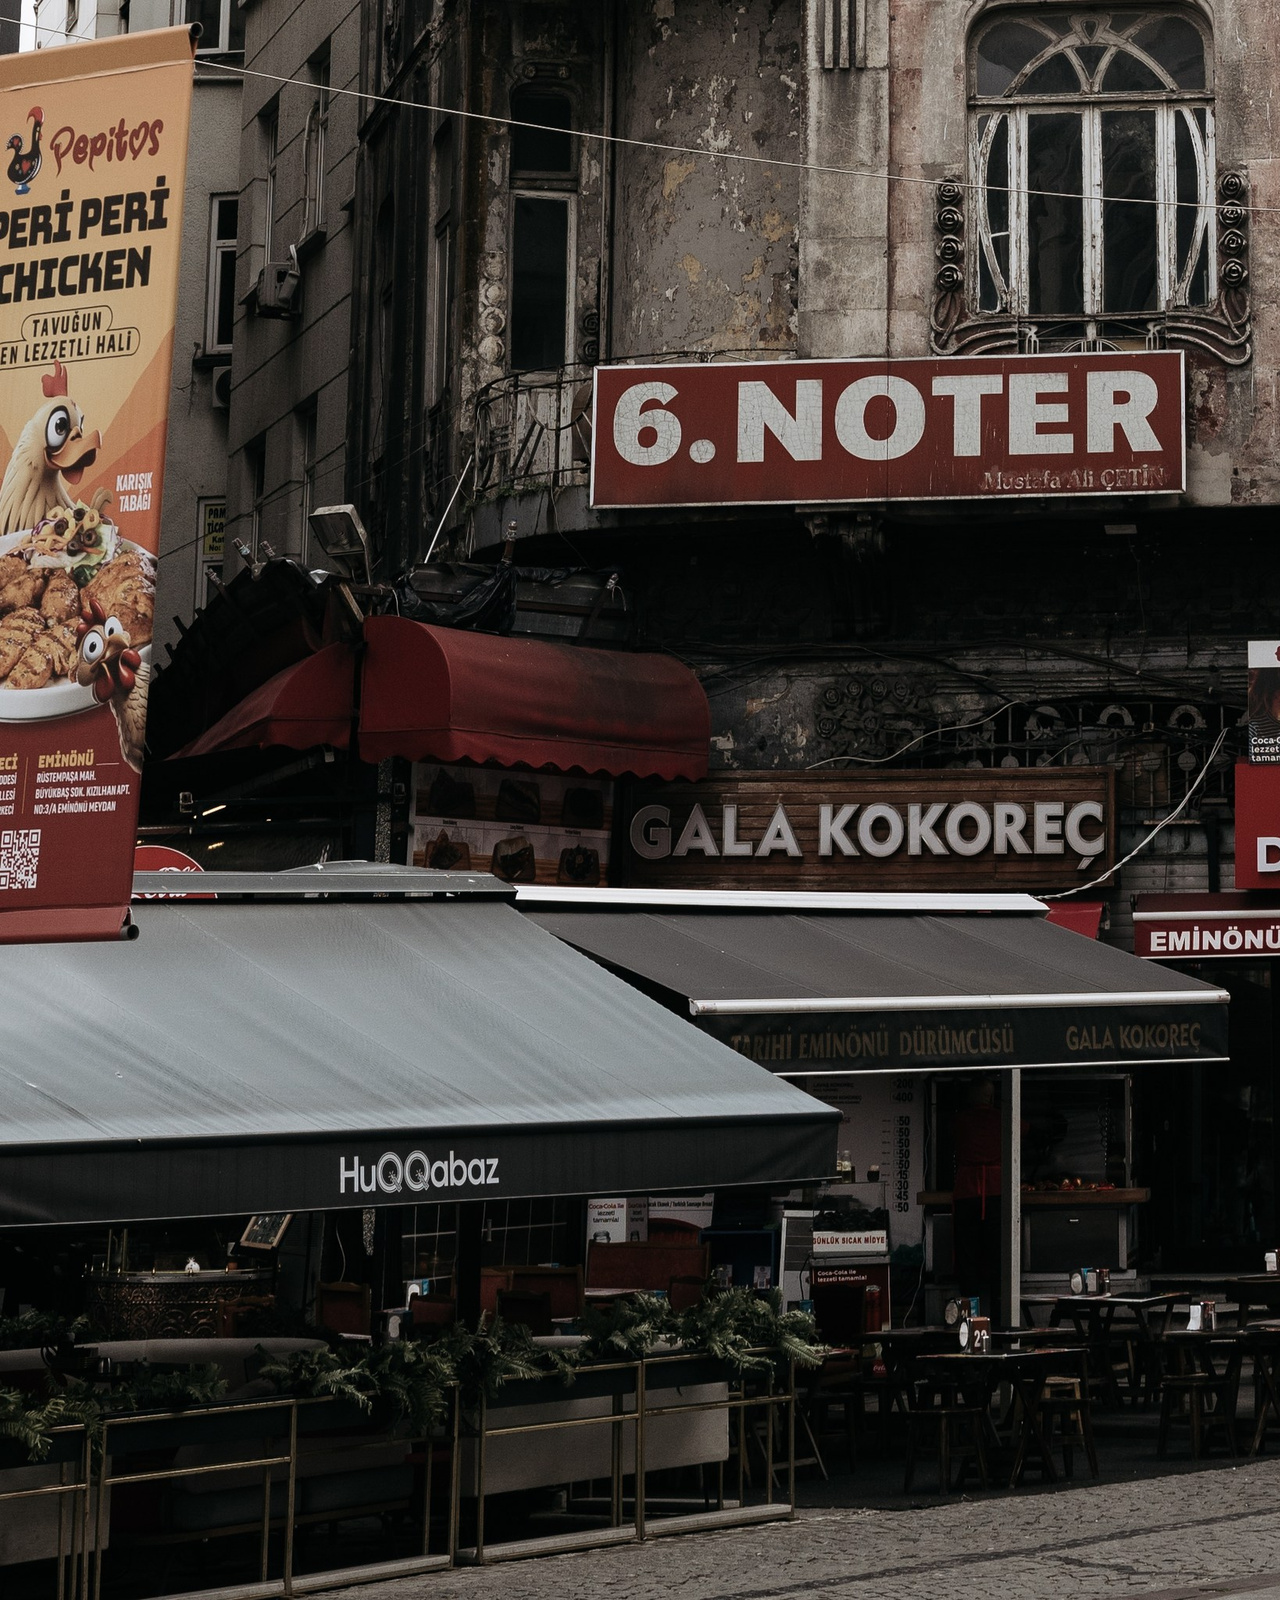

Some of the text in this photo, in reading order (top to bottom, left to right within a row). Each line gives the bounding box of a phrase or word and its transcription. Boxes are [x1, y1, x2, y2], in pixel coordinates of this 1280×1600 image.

[50, 118, 164, 177] Pepitos
[78, 175, 170, 240] PERİ
[0, 245, 152, 305] CHICKEN
[33, 311, 102, 338] TAVUĞUN
[24, 335, 91, 363] LEZZETLİ
[96, 330, 131, 354] HALİ
[116, 472, 153, 494] KARIŞIK
[1066, 469, 1094, 489] Ali
[120, 490, 151, 512] TABAĞI
[38, 749, 94, 768] EMİNÖNÜ
[630, 800, 1106, 871] GALA KOKOREÇ
[798, 1021, 889, 1059] EMİNÖNÜ
[899, 1021, 1014, 1057] DÜRÜMCÜSÜ
[1066, 1020, 1202, 1056] GALA KOKOREÇ
[340, 1150, 499, 1194] HuQQabaz
[864, 1235, 884, 1243] MİDYE
